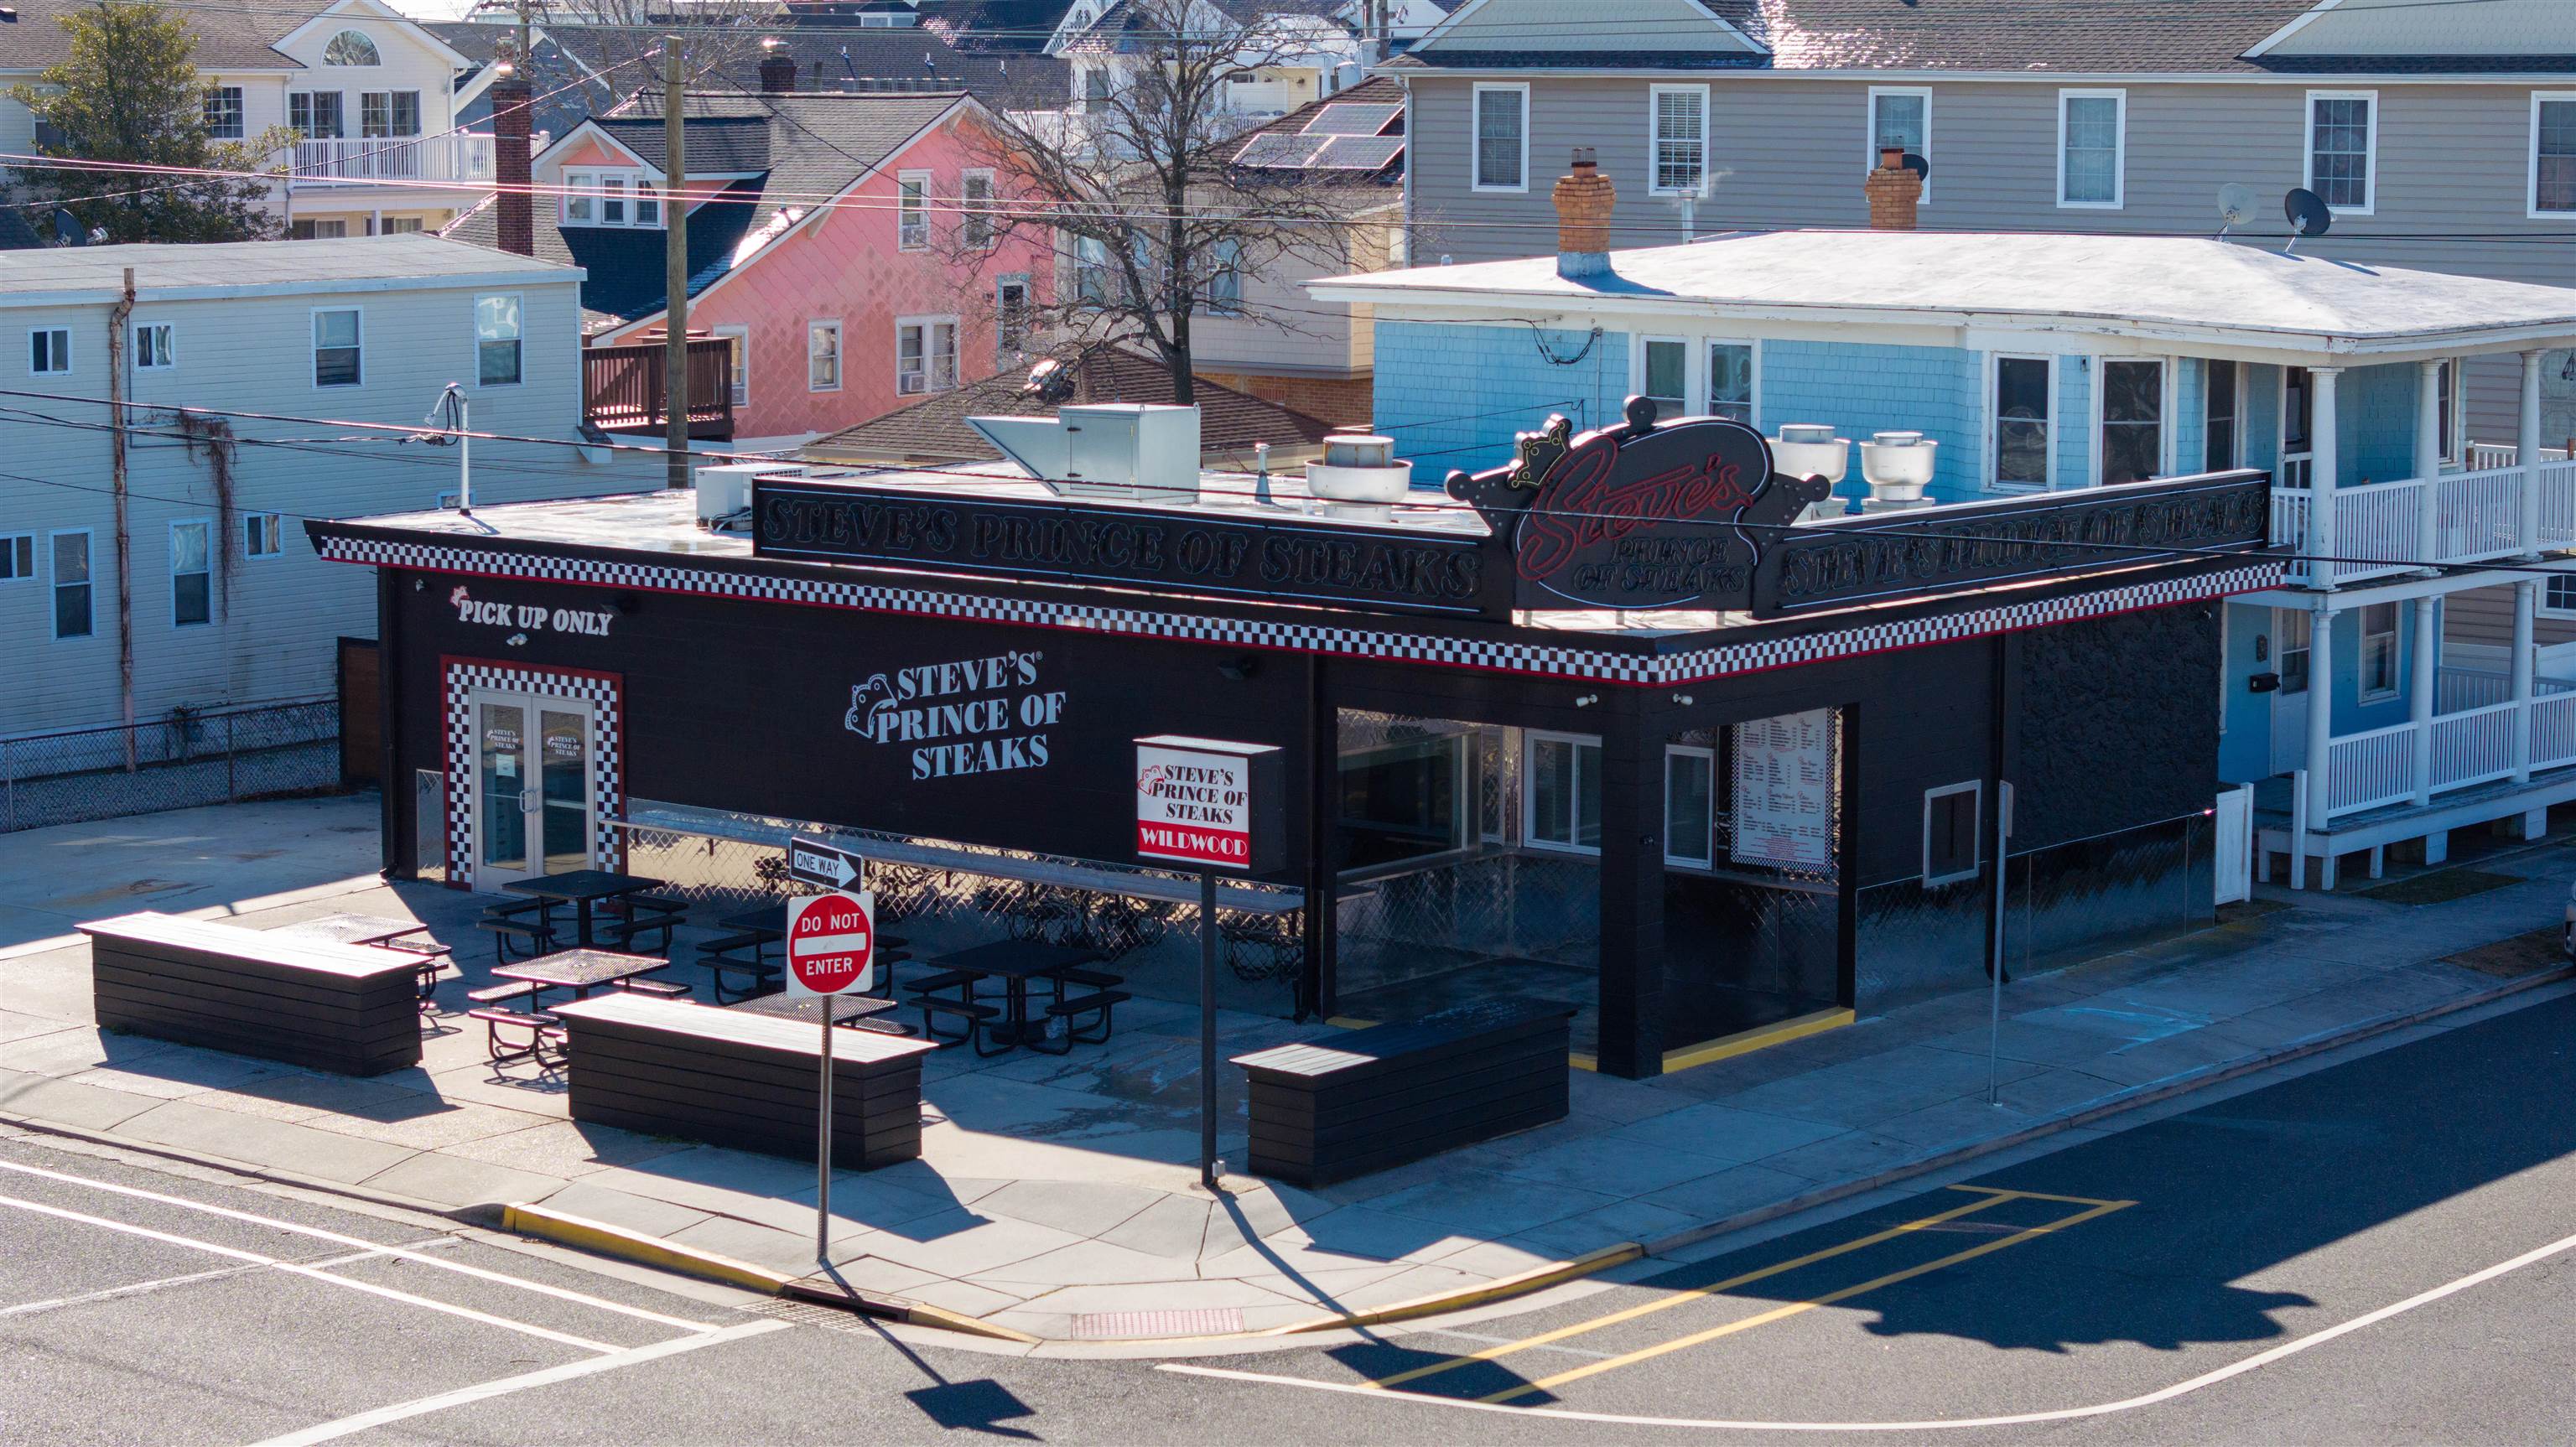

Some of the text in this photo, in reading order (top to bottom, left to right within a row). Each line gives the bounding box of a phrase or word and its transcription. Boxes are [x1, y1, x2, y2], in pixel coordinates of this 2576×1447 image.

[1516, 433, 1754, 581] Steve's
[763, 497, 1483, 599] STEVE'S PRINCE OF STEAKS
[1609, 537, 1732, 566] PRINCE
[1572, 563, 1748, 593] OF STEAKS
[459, 599, 614, 636] PICK UP ONLY
[875, 691, 1067, 744] PRINCE OF
[912, 734, 1049, 781] STEAKS
[1165, 765, 1234, 786] STEVE'S
[1152, 782, 1248, 806] PRINCE OF
[1166, 802, 1233, 825] STEAKS
[1140, 827, 1248, 856] WILDWOOD
[797, 853, 839, 877] ONE WAY
[802, 912, 860, 932] DO NOT
[806, 957, 853, 976] ENTER
